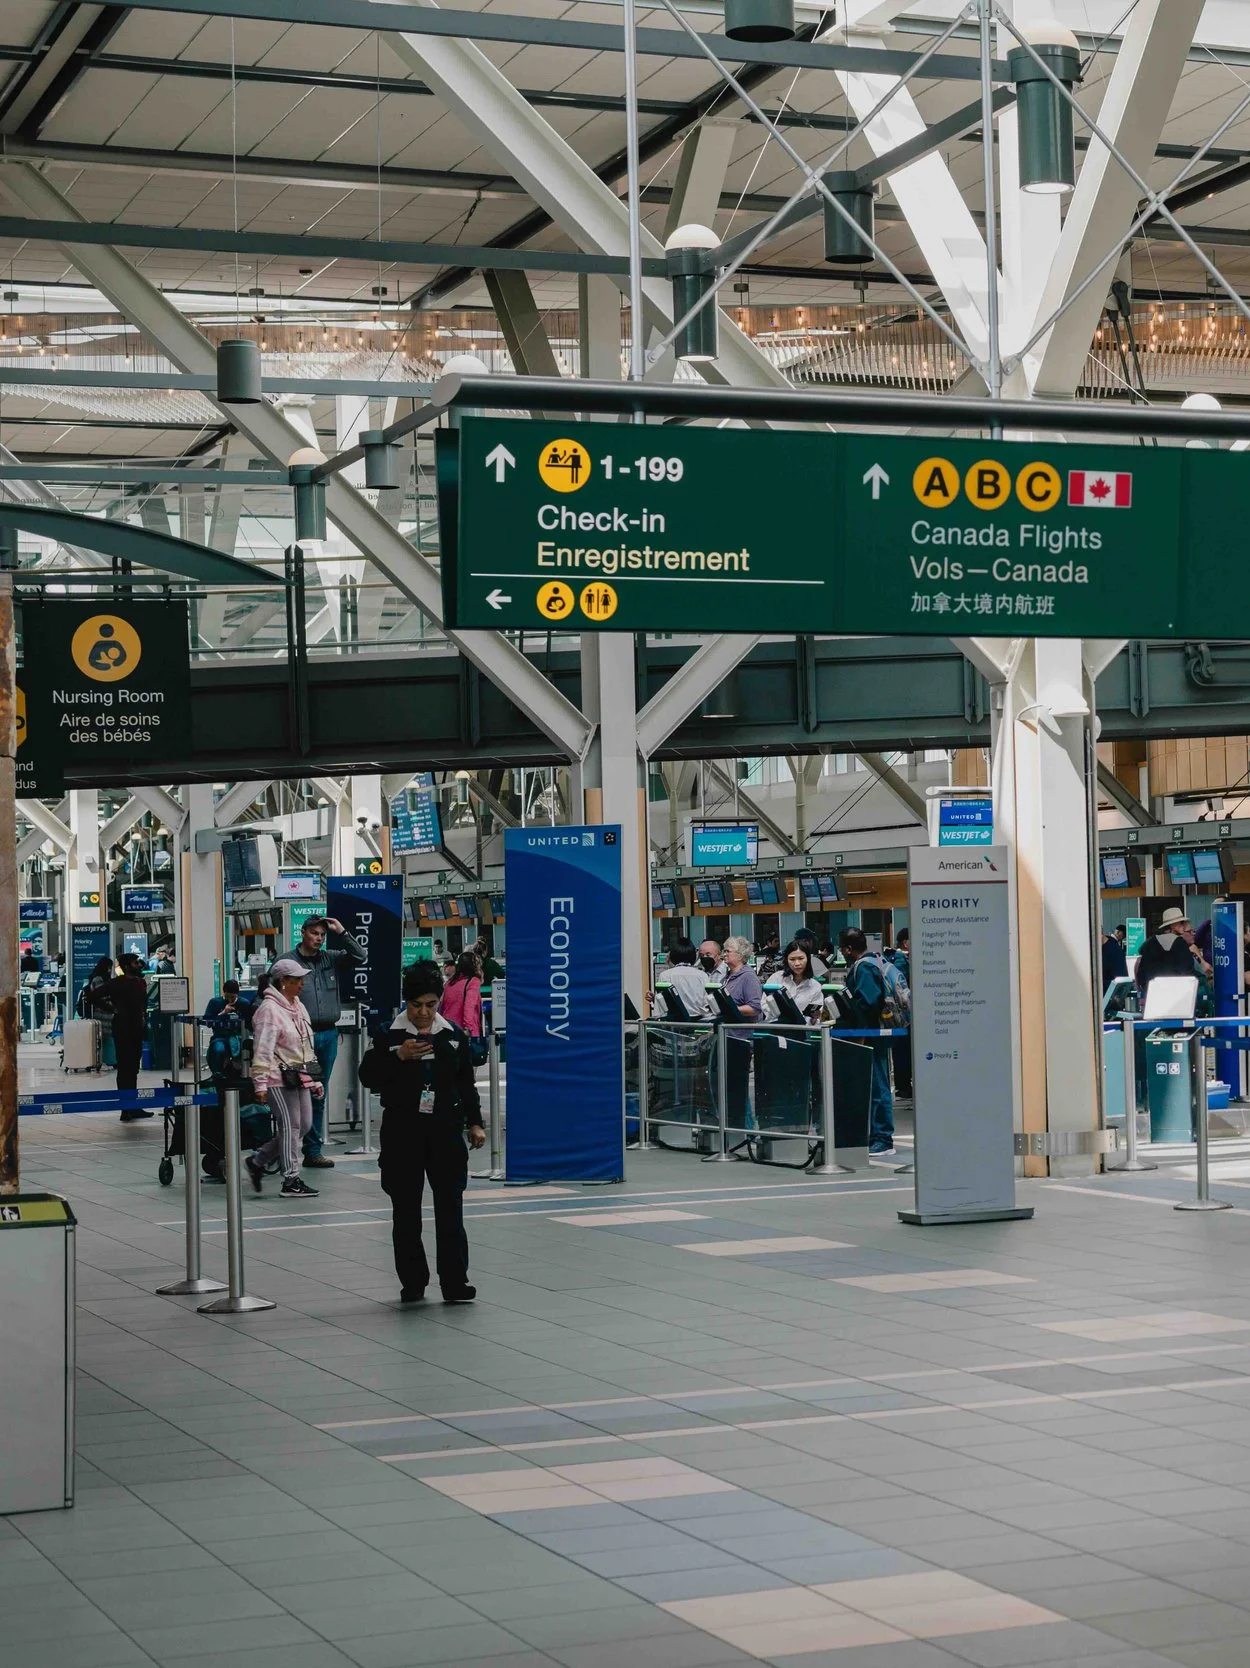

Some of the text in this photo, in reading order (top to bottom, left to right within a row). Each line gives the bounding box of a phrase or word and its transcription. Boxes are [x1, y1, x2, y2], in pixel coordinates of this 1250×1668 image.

[600, 455, 684, 482] 1-199
[922, 467, 950, 498] A
[976, 469, 1001, 498] B
[1026, 470, 1053, 502] C
[536, 504, 666, 534] Check-in
[911, 520, 1102, 554] Canada Flights
[537, 542, 750, 575] Enregistrement
[910, 591, 1055, 616] 加拿大境内航班
[52, 689, 164, 707] Nursing Room
[60, 712, 160, 727] Aire de soins
[70, 728, 151, 744] des bébés
[528, 836, 578, 846] UNITED
[942, 831, 980, 841] WESTJET
[698, 844, 732, 854] WESTJET
[938, 861, 983, 870] American
[921, 898, 979, 909] PRIORITY
[922, 916, 954, 924] Customer
[546, 897, 574, 1040] Economy
